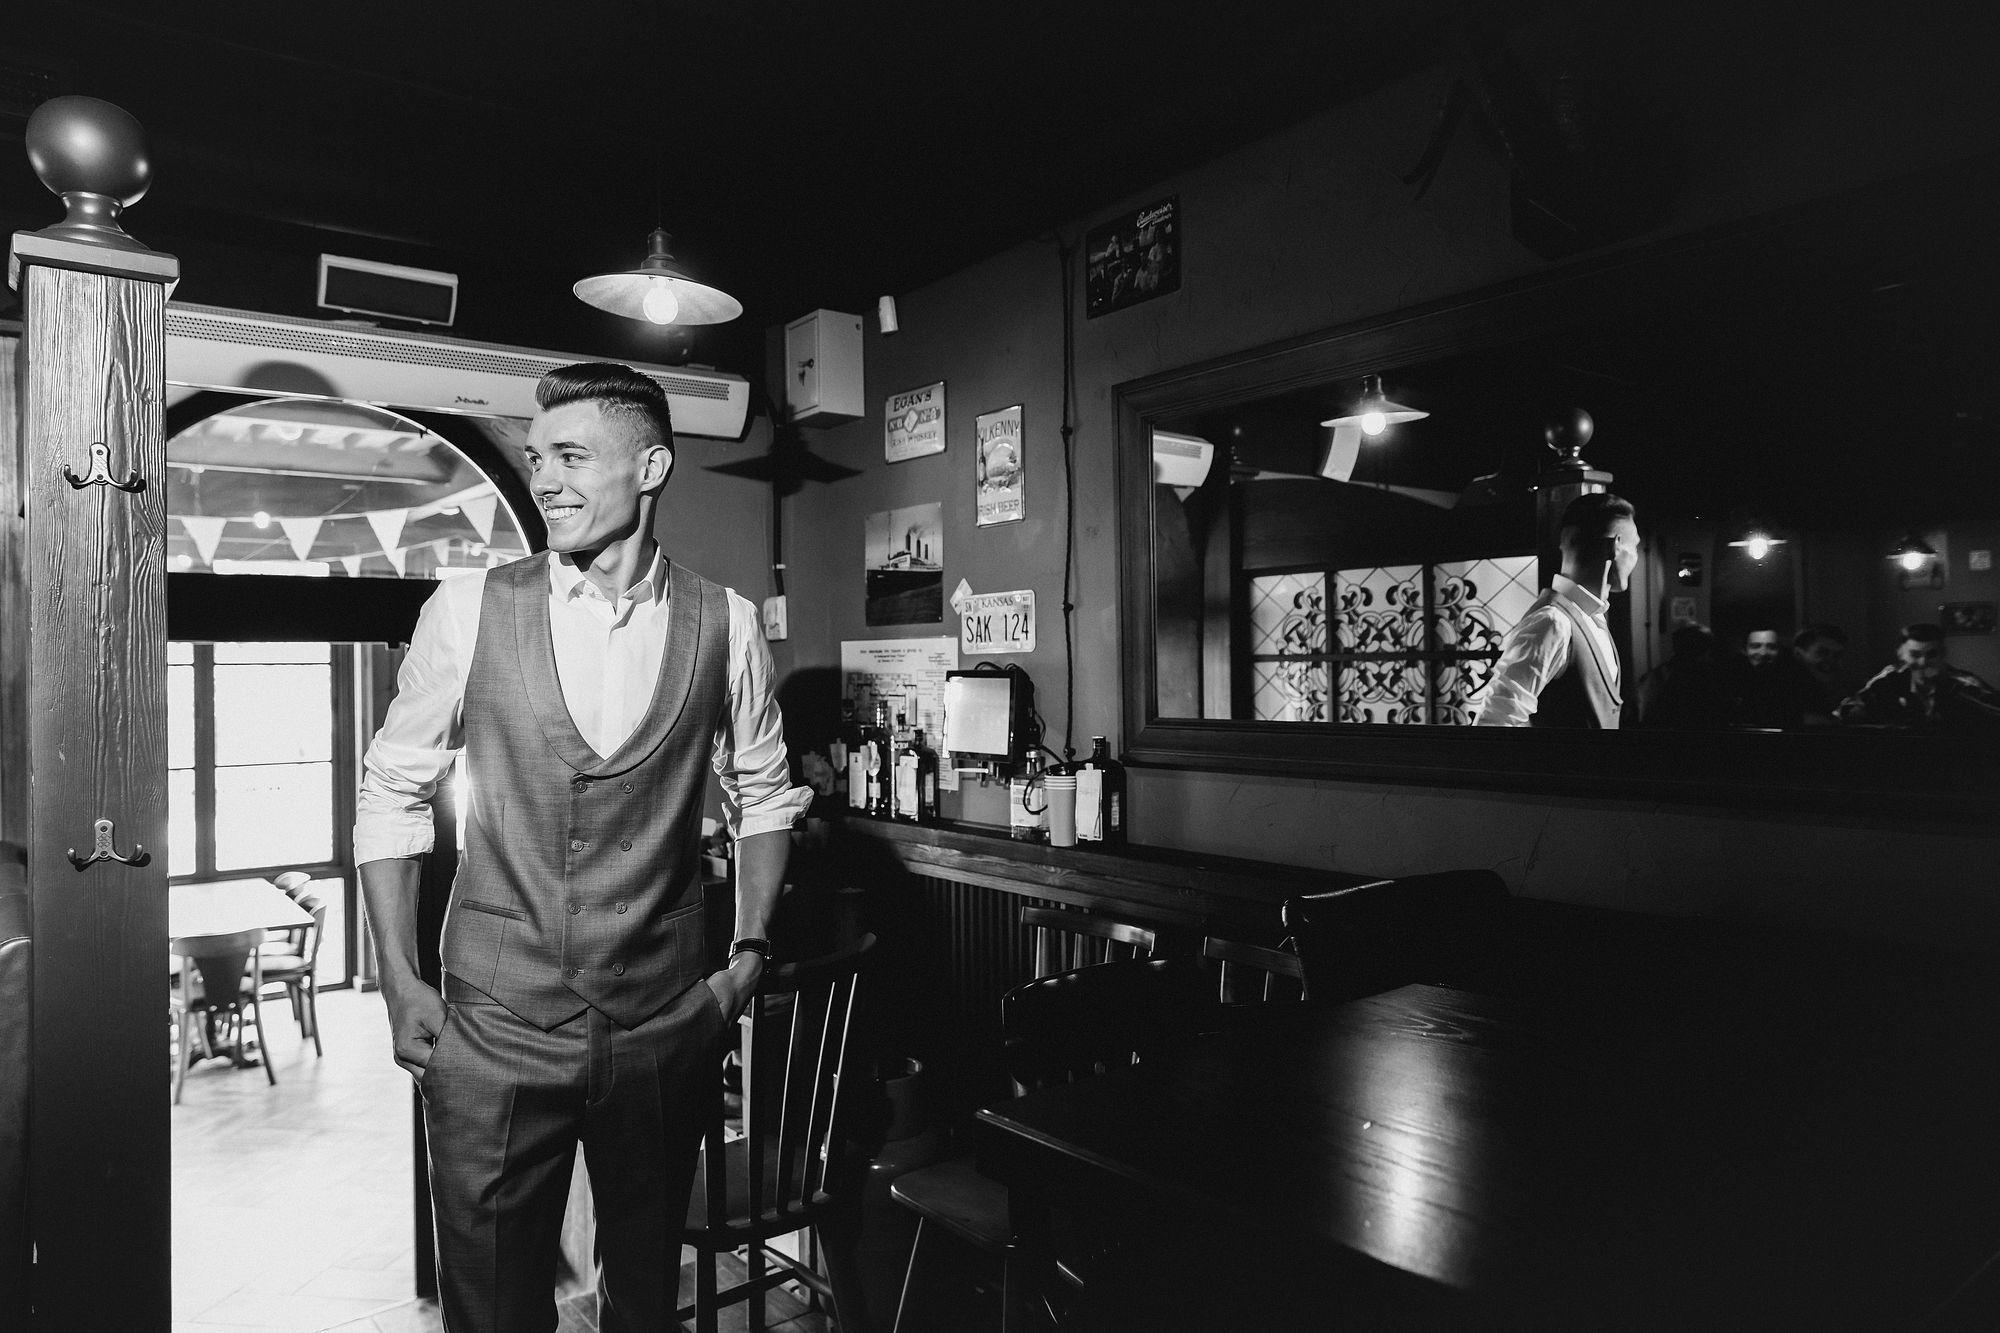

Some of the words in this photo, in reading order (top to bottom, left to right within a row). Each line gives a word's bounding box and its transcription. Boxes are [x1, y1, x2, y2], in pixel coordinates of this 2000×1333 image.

[893, 391, 932, 412] EGAN'S
[998, 498, 1020, 513] BEER
[981, 596, 1015, 609] KANSAS
[966, 615, 992, 644] SAK
[1004, 612, 1030, 643] 124
